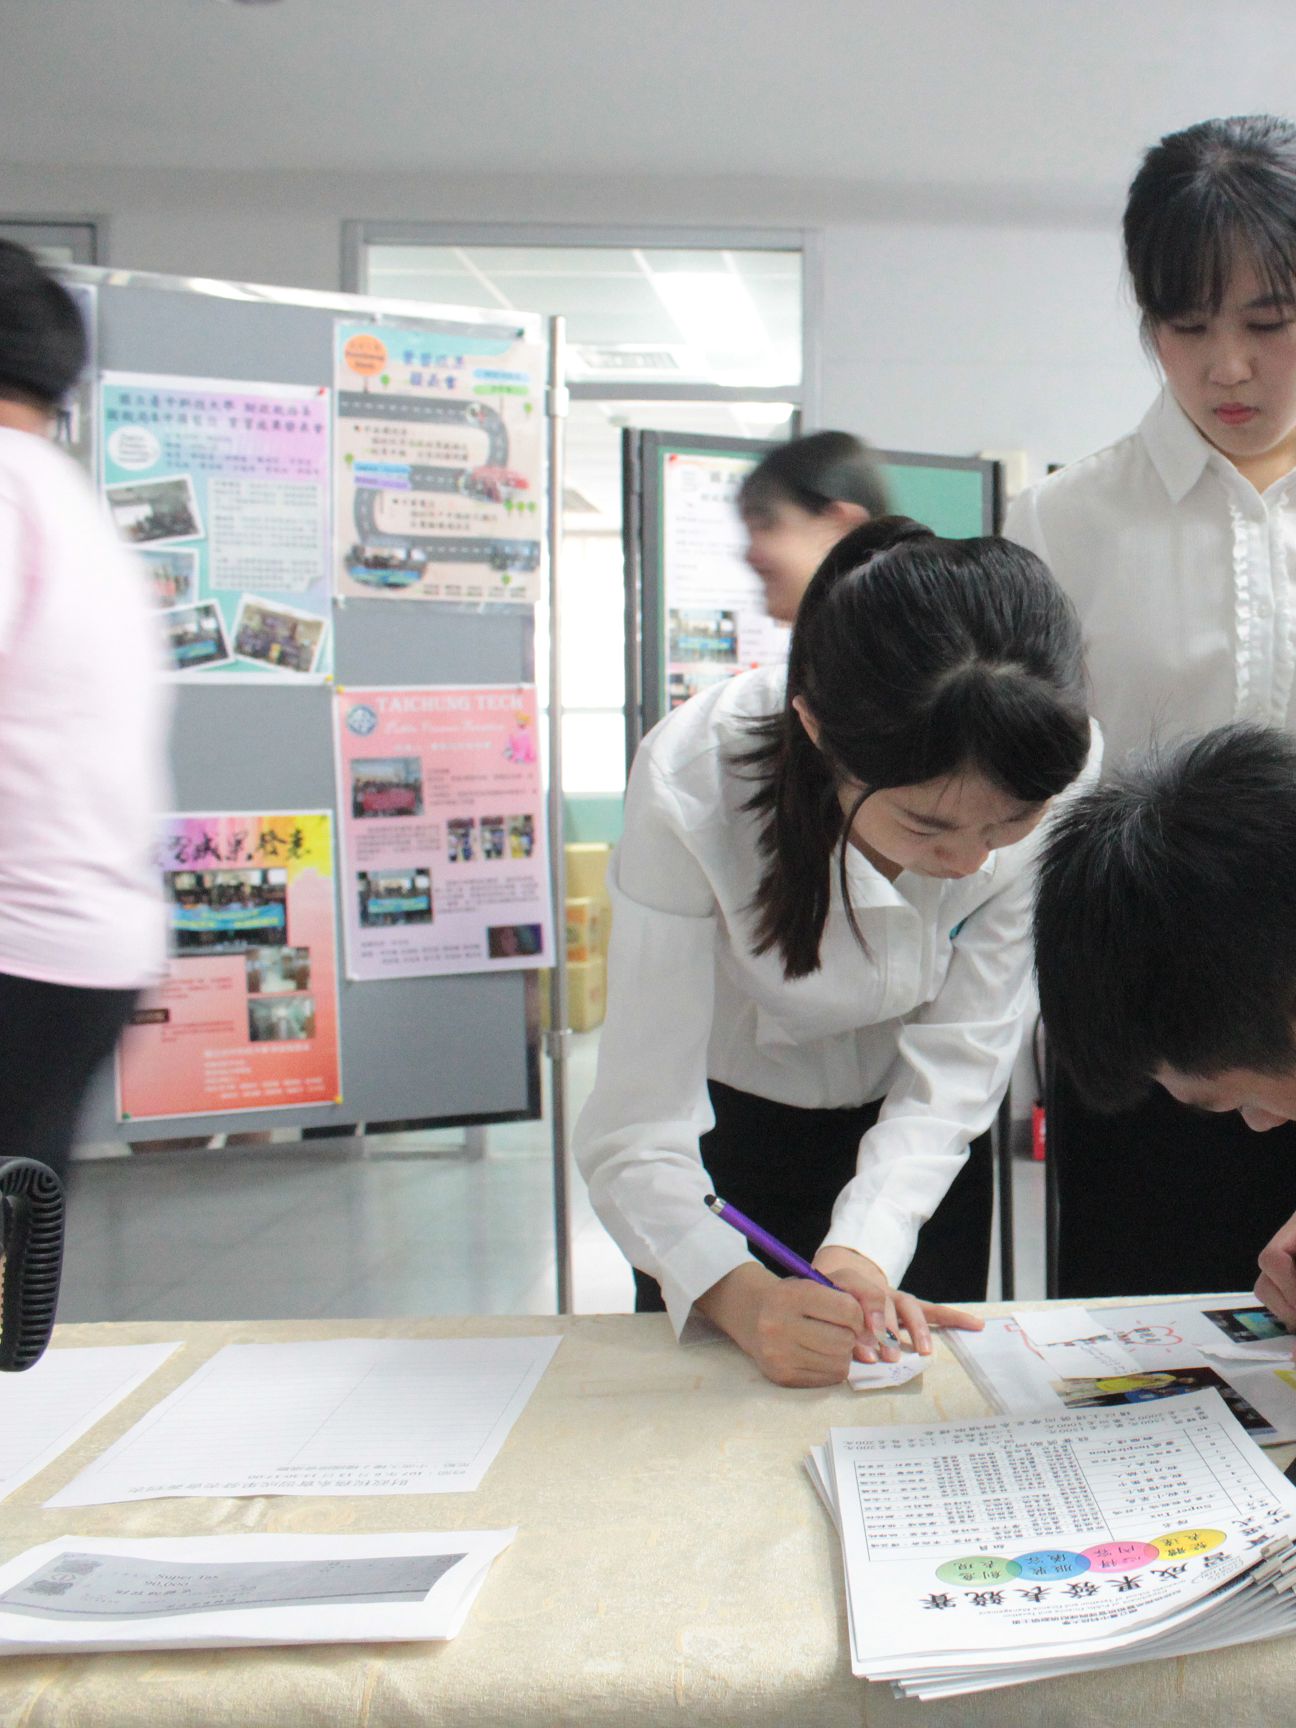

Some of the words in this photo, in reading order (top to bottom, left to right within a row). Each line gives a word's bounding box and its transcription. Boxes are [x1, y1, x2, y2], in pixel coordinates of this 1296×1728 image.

[1095, 1544, 1136, 1558] 內容
[954, 1560, 994, 1571] 表現
[1025, 1553, 1069, 1566] 儀容
[1100, 1555, 1142, 1569] 心得
[960, 1570, 1001, 1582] 創意
[1032, 1563, 1073, 1576] 服裝
